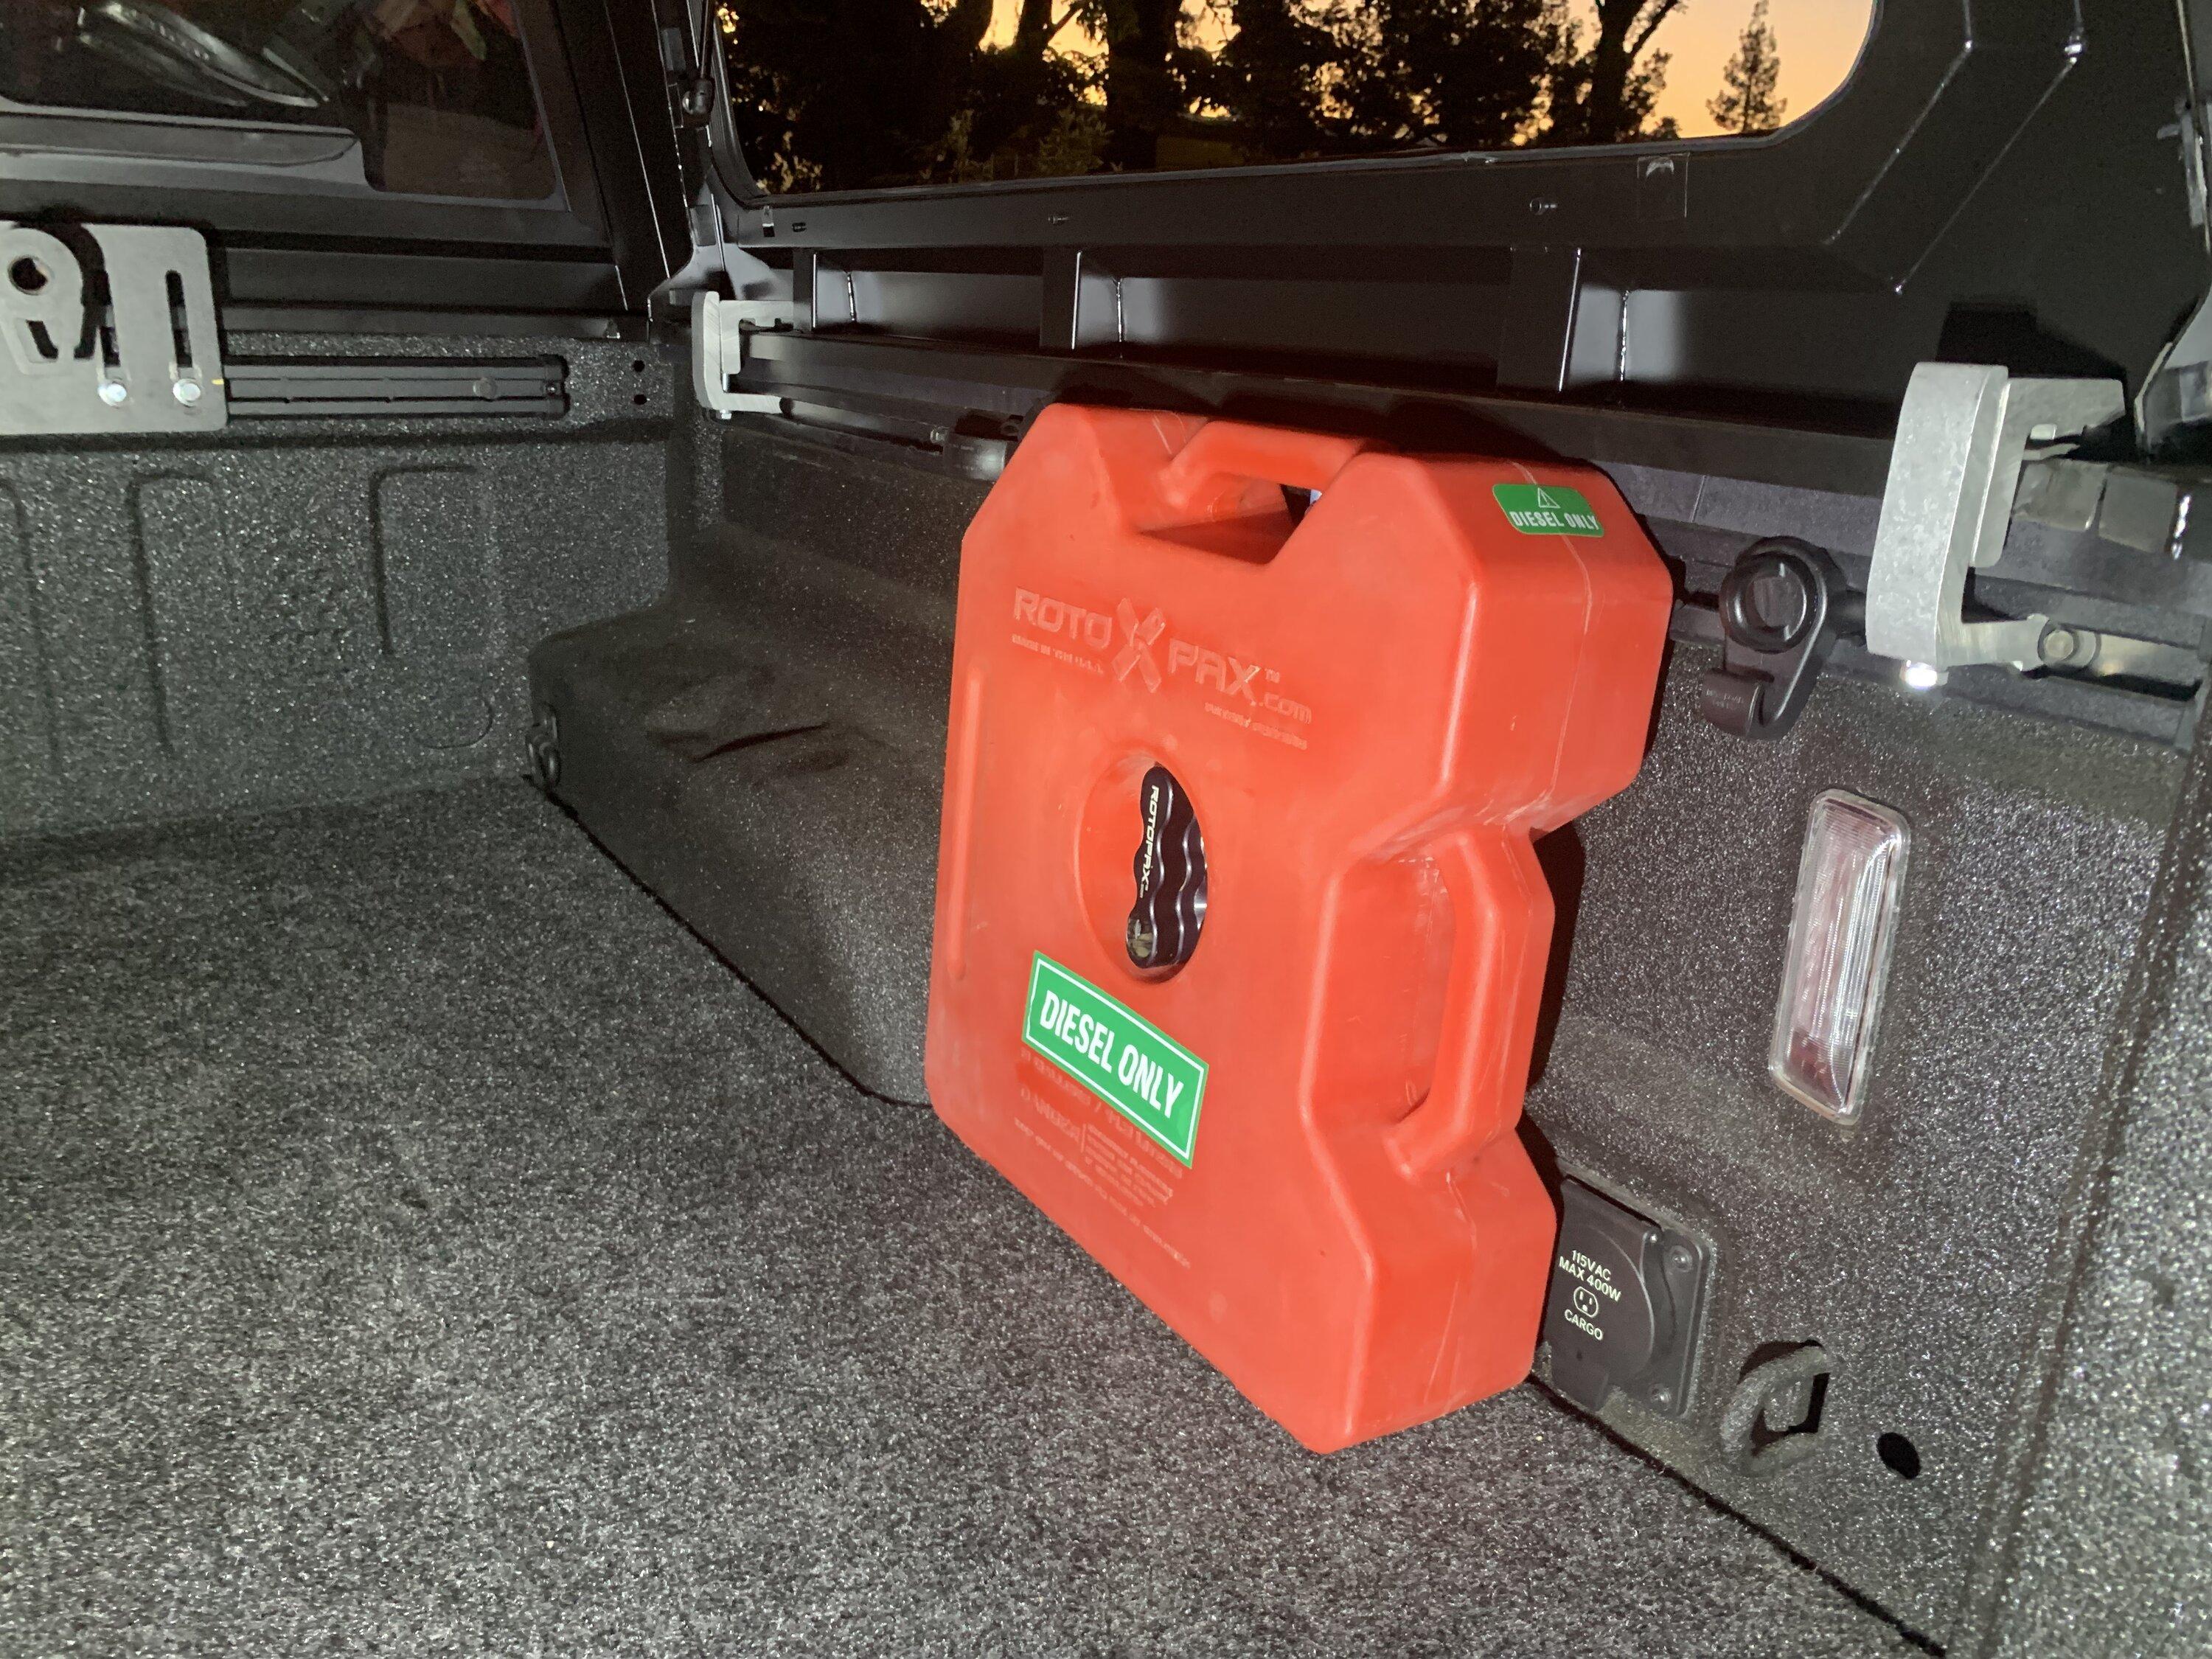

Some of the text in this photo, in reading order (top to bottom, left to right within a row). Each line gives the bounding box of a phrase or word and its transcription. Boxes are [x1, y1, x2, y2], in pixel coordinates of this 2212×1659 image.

[1509, 511, 1599, 531] DIESEL ONLY
[1012, 588, 1113, 650] ROTO
[1139, 785, 1160, 899] ROTOPAX
[1040, 989, 1116, 1074] DIESEL
[1118, 1044, 1185, 1119] ONLY
[1559, 1256, 1622, 1302] MAX 400W
[1572, 1250, 1612, 1281] 115VAC
[1564, 1309, 1604, 1340] CARGO
